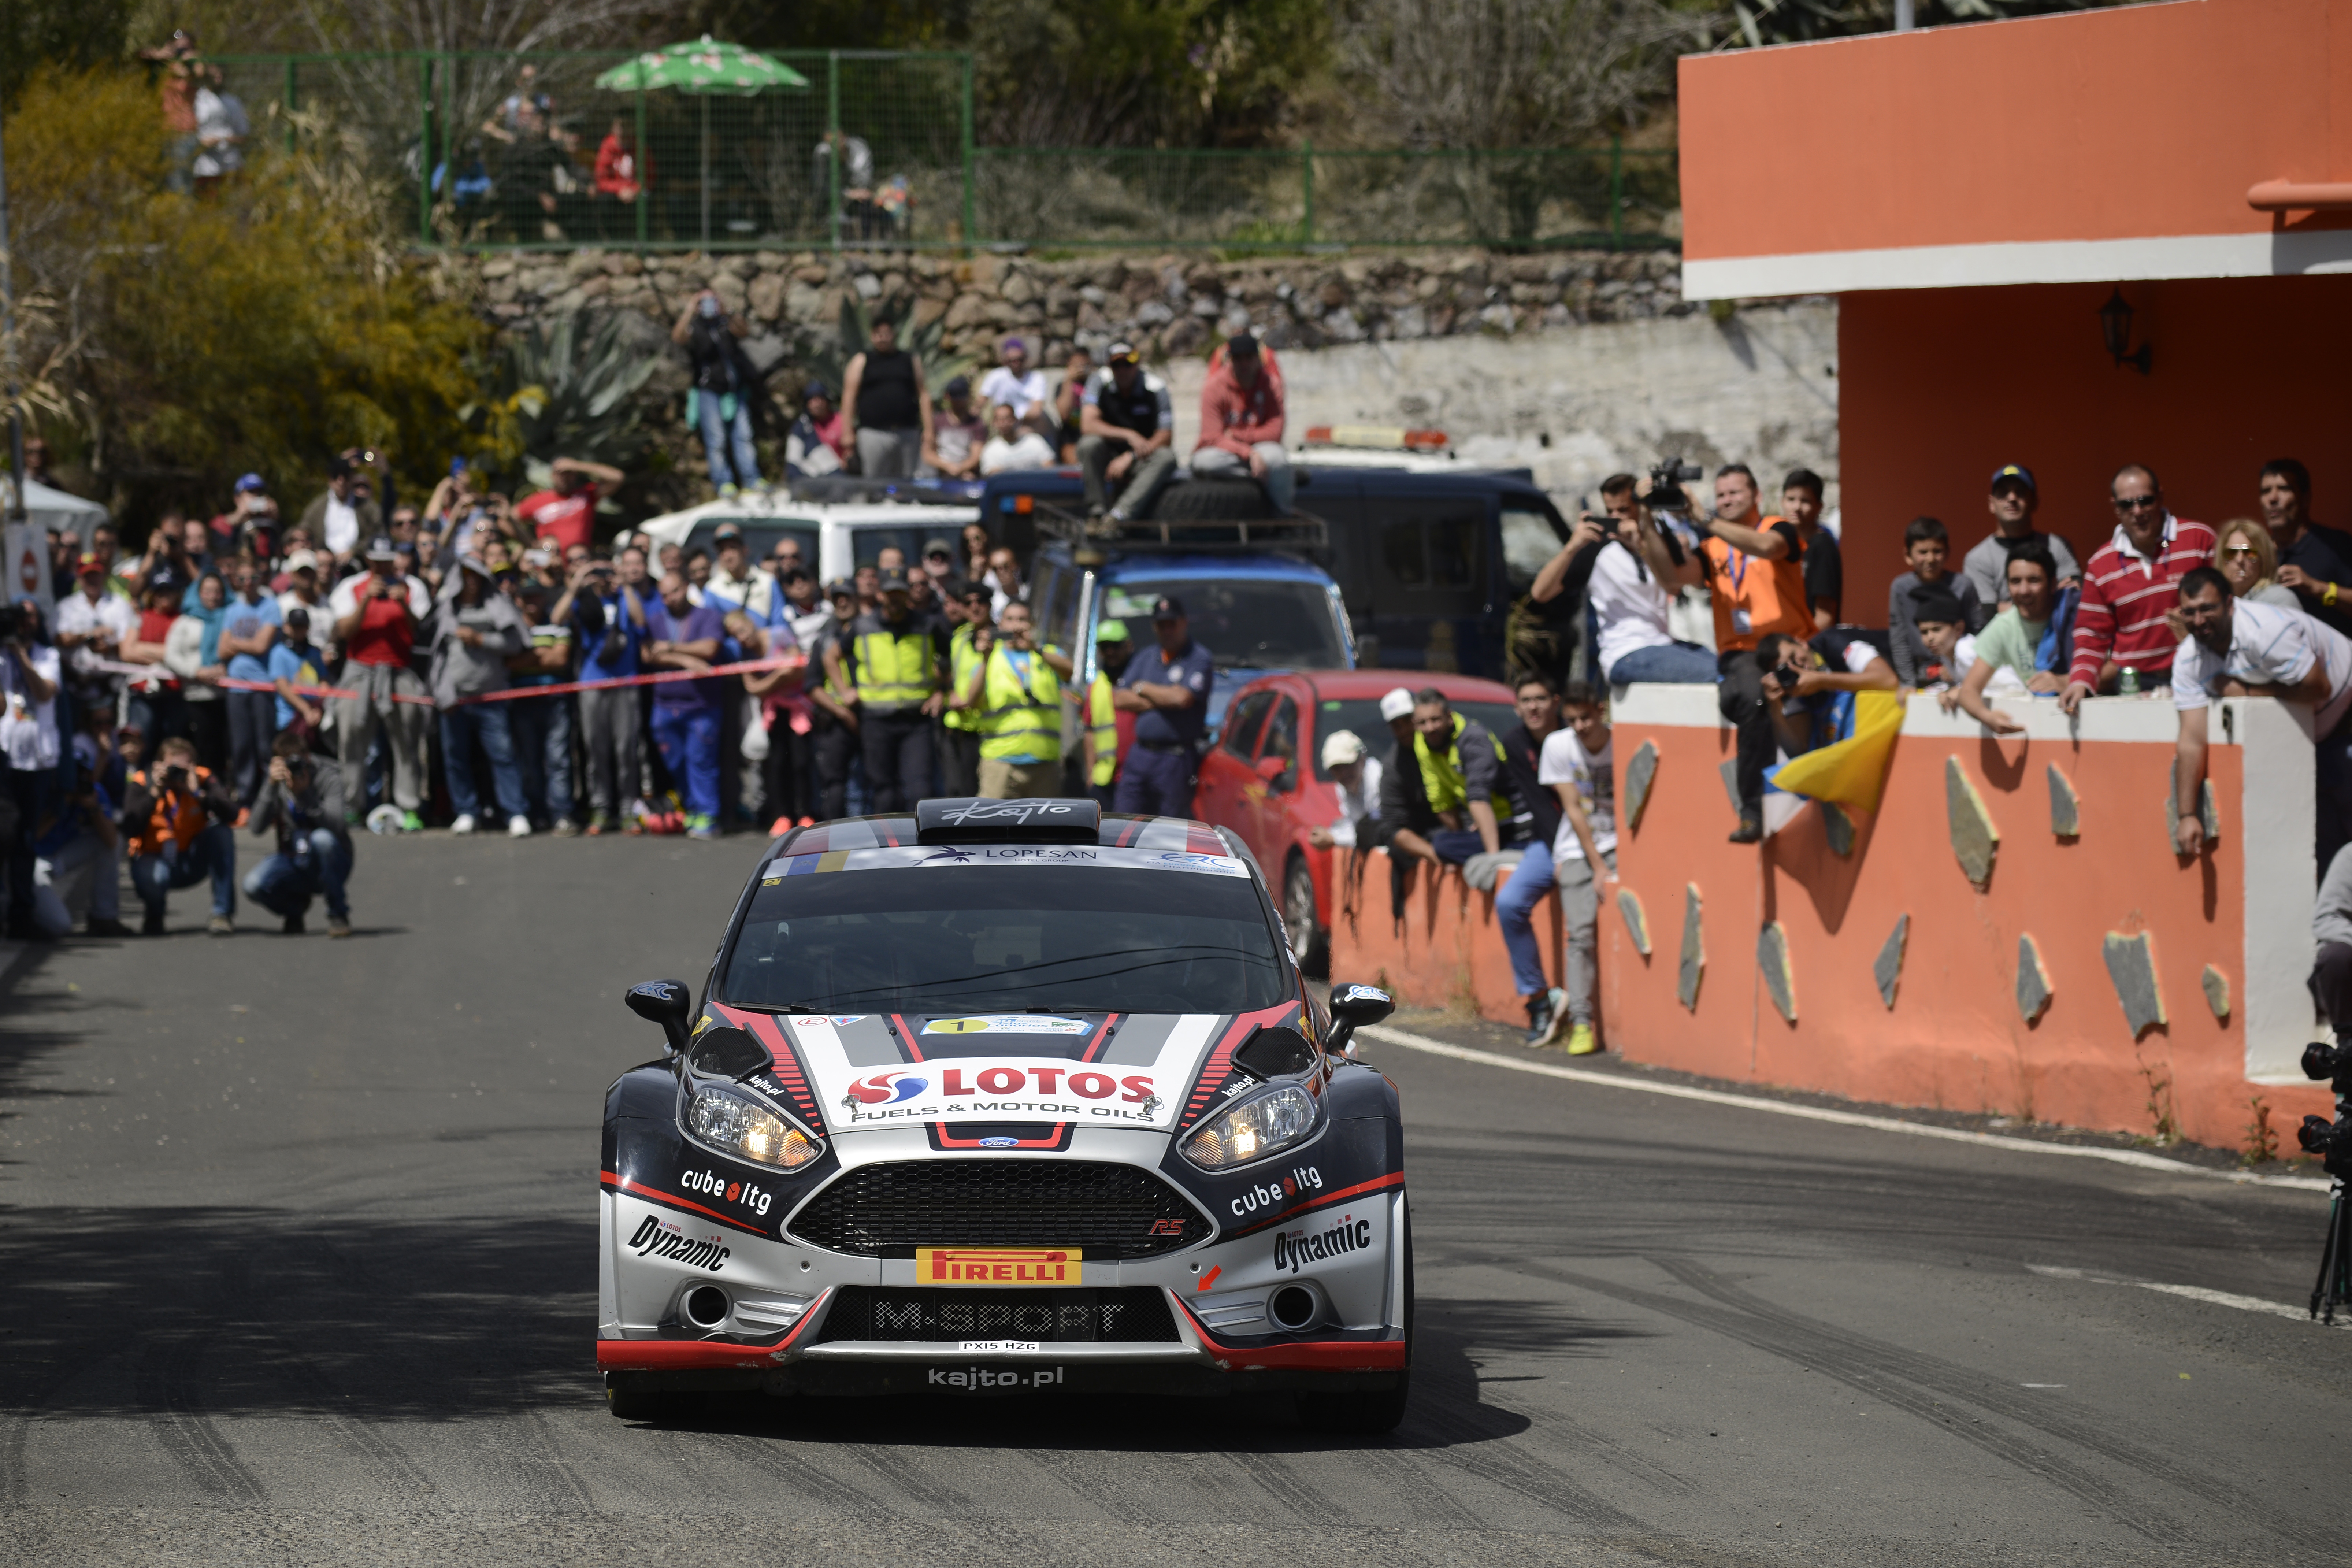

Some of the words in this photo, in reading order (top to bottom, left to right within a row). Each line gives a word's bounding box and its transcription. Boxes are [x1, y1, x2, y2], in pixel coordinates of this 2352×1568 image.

[986, 850, 1097, 860] LOPESAN
[1163, 865, 1235, 874] CHAMPIONSHIP
[950, 1021, 965, 1031] 1
[749, 1075, 784, 1096] kajto.pl
[943, 1067, 1153, 1103] LOTOS
[1221, 1075, 1255, 1097] kajto.pl
[851, 1107, 939, 1123] FUELS
[974, 1103, 1080, 1113] MOTOR
[1091, 1108, 1154, 1122] OILS
[681, 1170, 725, 1196] cube
[740, 1183, 772, 1215] itg
[1231, 1183, 1283, 1216] cube
[1293, 1167, 1322, 1190] itg
[666, 1223, 681, 1233] LOTOS
[1292, 1229, 1303, 1237] LOTOS
[628, 1214, 730, 1271] Dynamic
[1274, 1219, 1370, 1274] Dynamic
[932, 1250, 1067, 1281] PIRELLI
[929, 1367, 1064, 1391] kajto.pl
